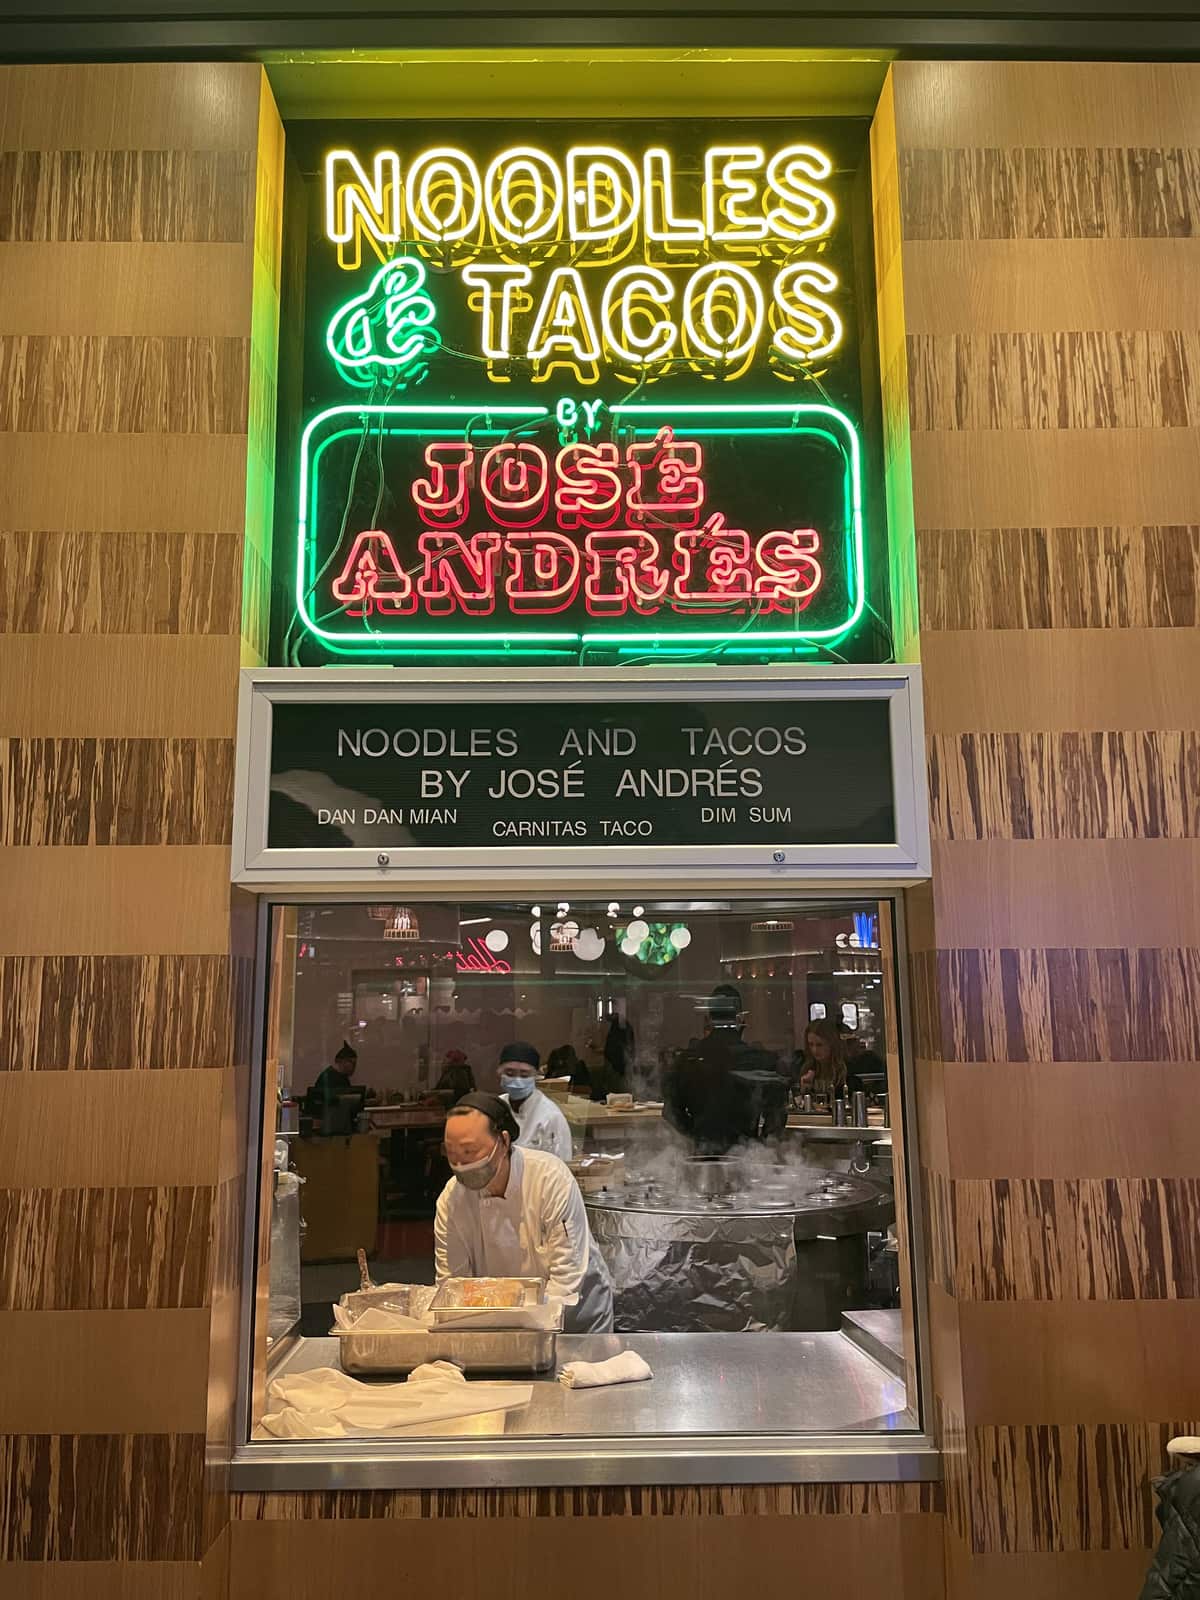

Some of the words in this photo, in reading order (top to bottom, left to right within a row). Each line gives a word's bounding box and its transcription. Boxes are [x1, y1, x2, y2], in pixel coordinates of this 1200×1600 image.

[325, 145, 837, 243] NOODLES
[326, 256, 436, 367] &
[463, 261, 843, 362] TACOS
[556, 397, 603, 428] BY
[412, 426, 704, 510] JOSÉ
[332, 512, 821, 600] ANDRÉS
[338, 728, 518, 758] NOODLES
[560, 728, 637, 757] AND
[681, 727, 807, 756] TACOS
[421, 769, 471, 799] BY
[488, 760, 585, 799] JOSÉ
[616, 759, 763, 798] ANDRÉS
[317, 808, 355, 825] DAN
[364, 808, 402, 825] DAN
[409, 808, 457, 825] MIAN
[492, 820, 587, 837] CARNITAS
[600, 820, 653, 837] TACO
[701, 807, 736, 823] DIM
[749, 806, 792, 823] SUM
